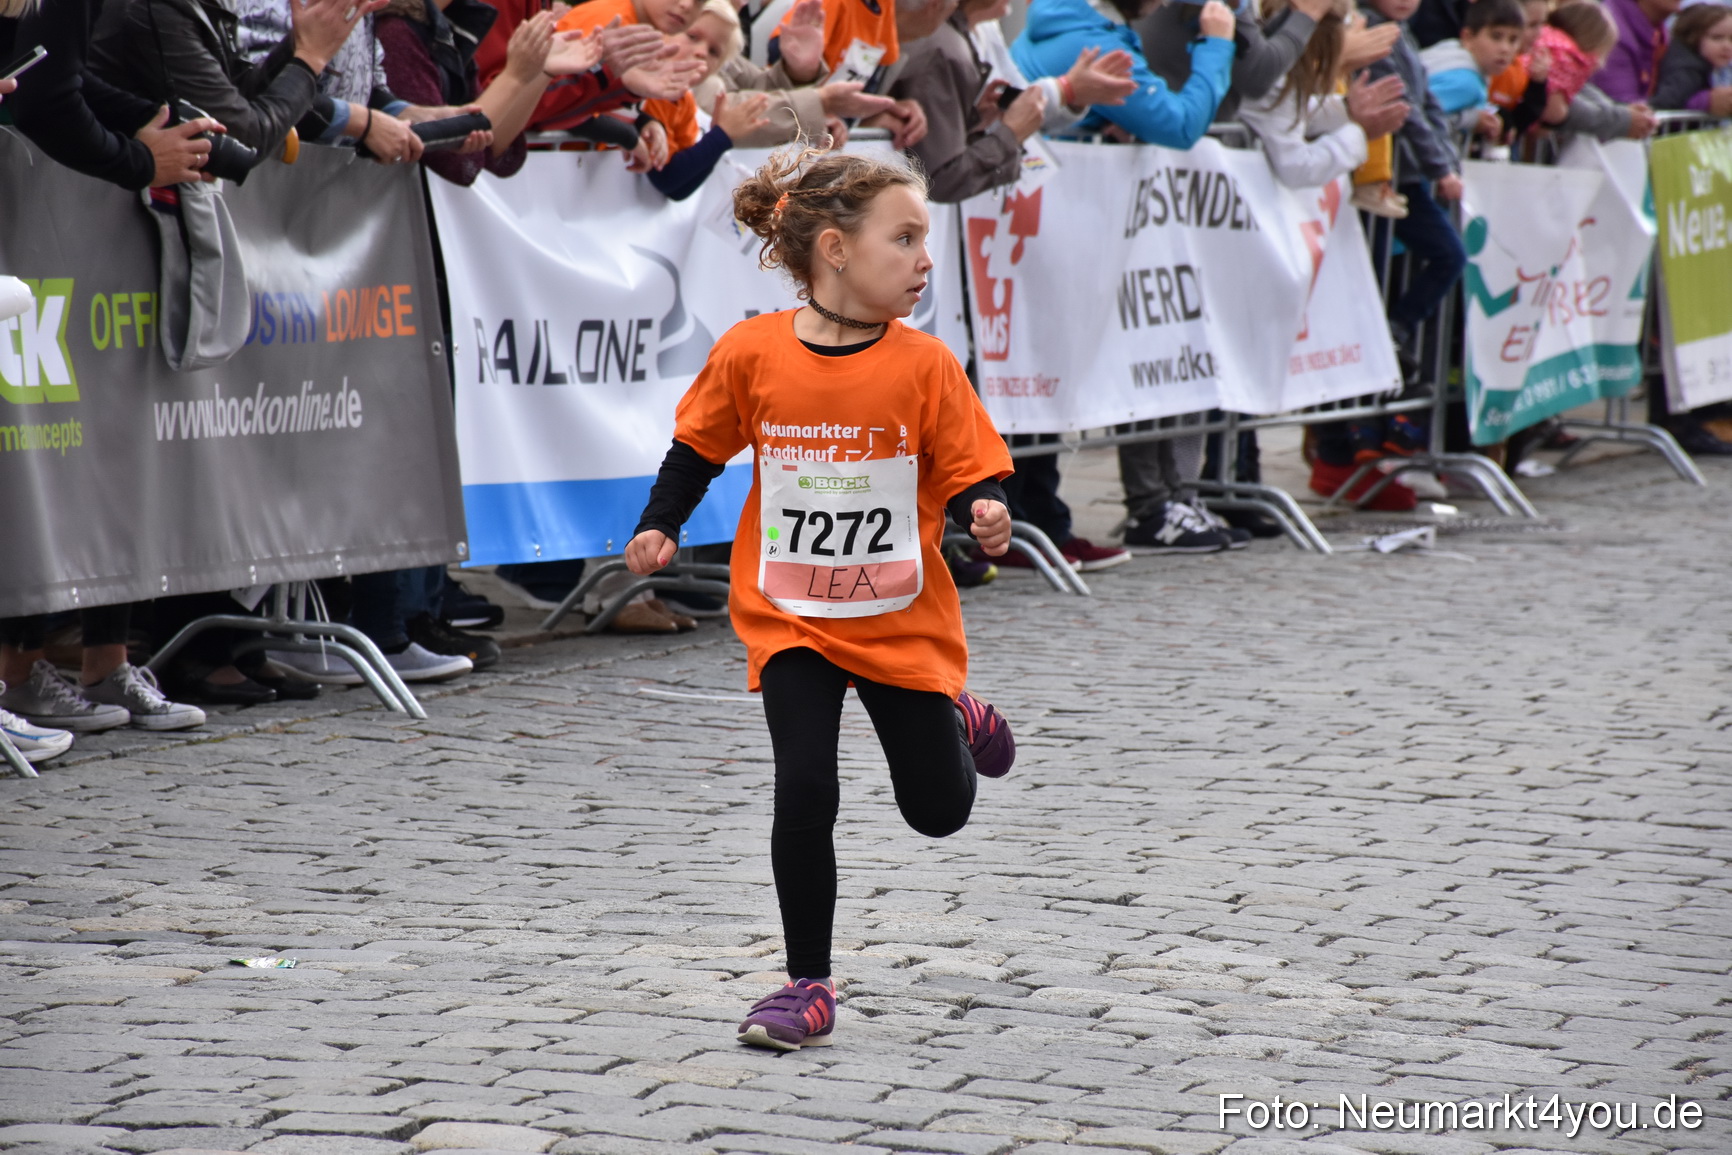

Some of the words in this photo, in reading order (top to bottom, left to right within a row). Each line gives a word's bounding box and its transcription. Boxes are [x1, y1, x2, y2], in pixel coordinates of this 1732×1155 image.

[321, 285, 417, 343] LOUNGE
[1117, 264, 1206, 331] WERD
[153, 376, 363, 442] www.bockonline.de
[761, 421, 862, 439] Neumarkter
[761, 444, 839, 463] Stadtlauf
[814, 475, 871, 490] BOCK
[782, 507, 894, 557] 7272
[807, 566, 878, 599] LEA
